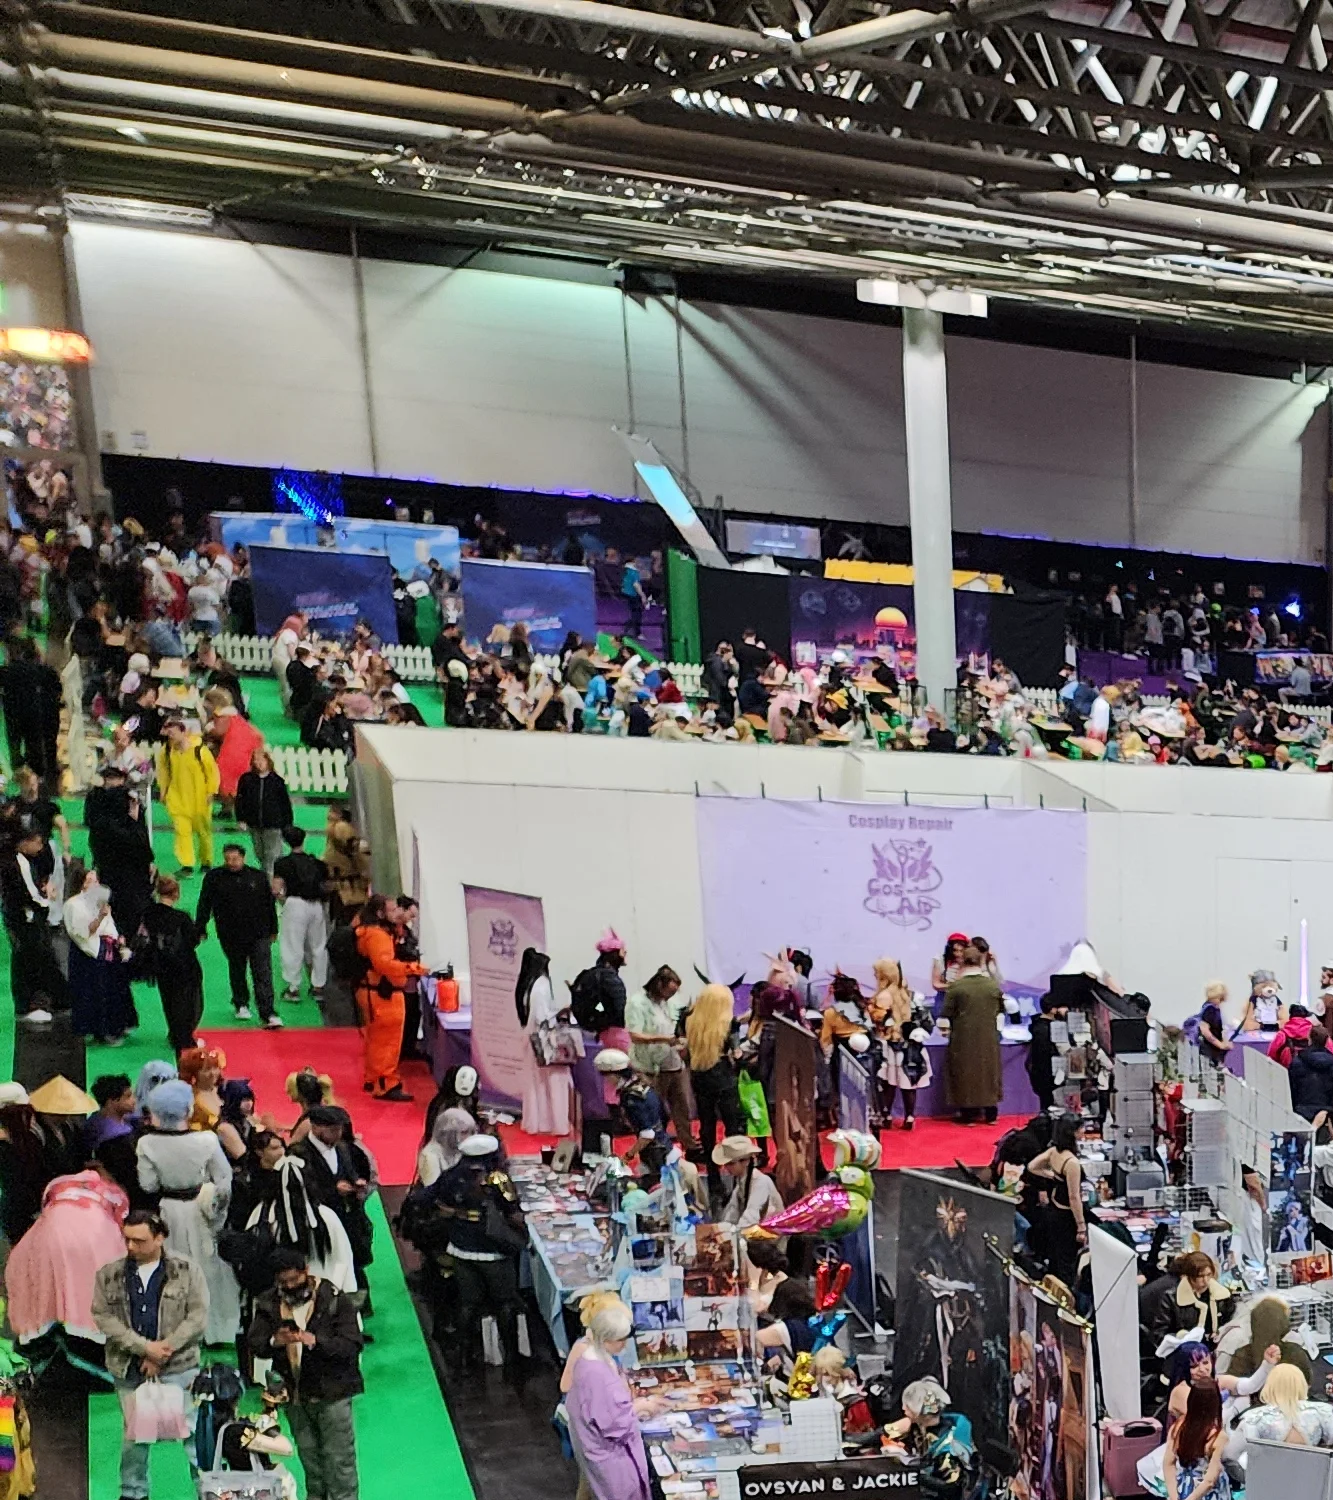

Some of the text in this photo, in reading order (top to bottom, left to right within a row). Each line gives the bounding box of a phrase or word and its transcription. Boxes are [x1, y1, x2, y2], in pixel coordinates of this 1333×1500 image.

[849, 815, 953, 831] Cosplay Repair
[745, 1472, 919, 1496] OVSYAN & JACKIE
